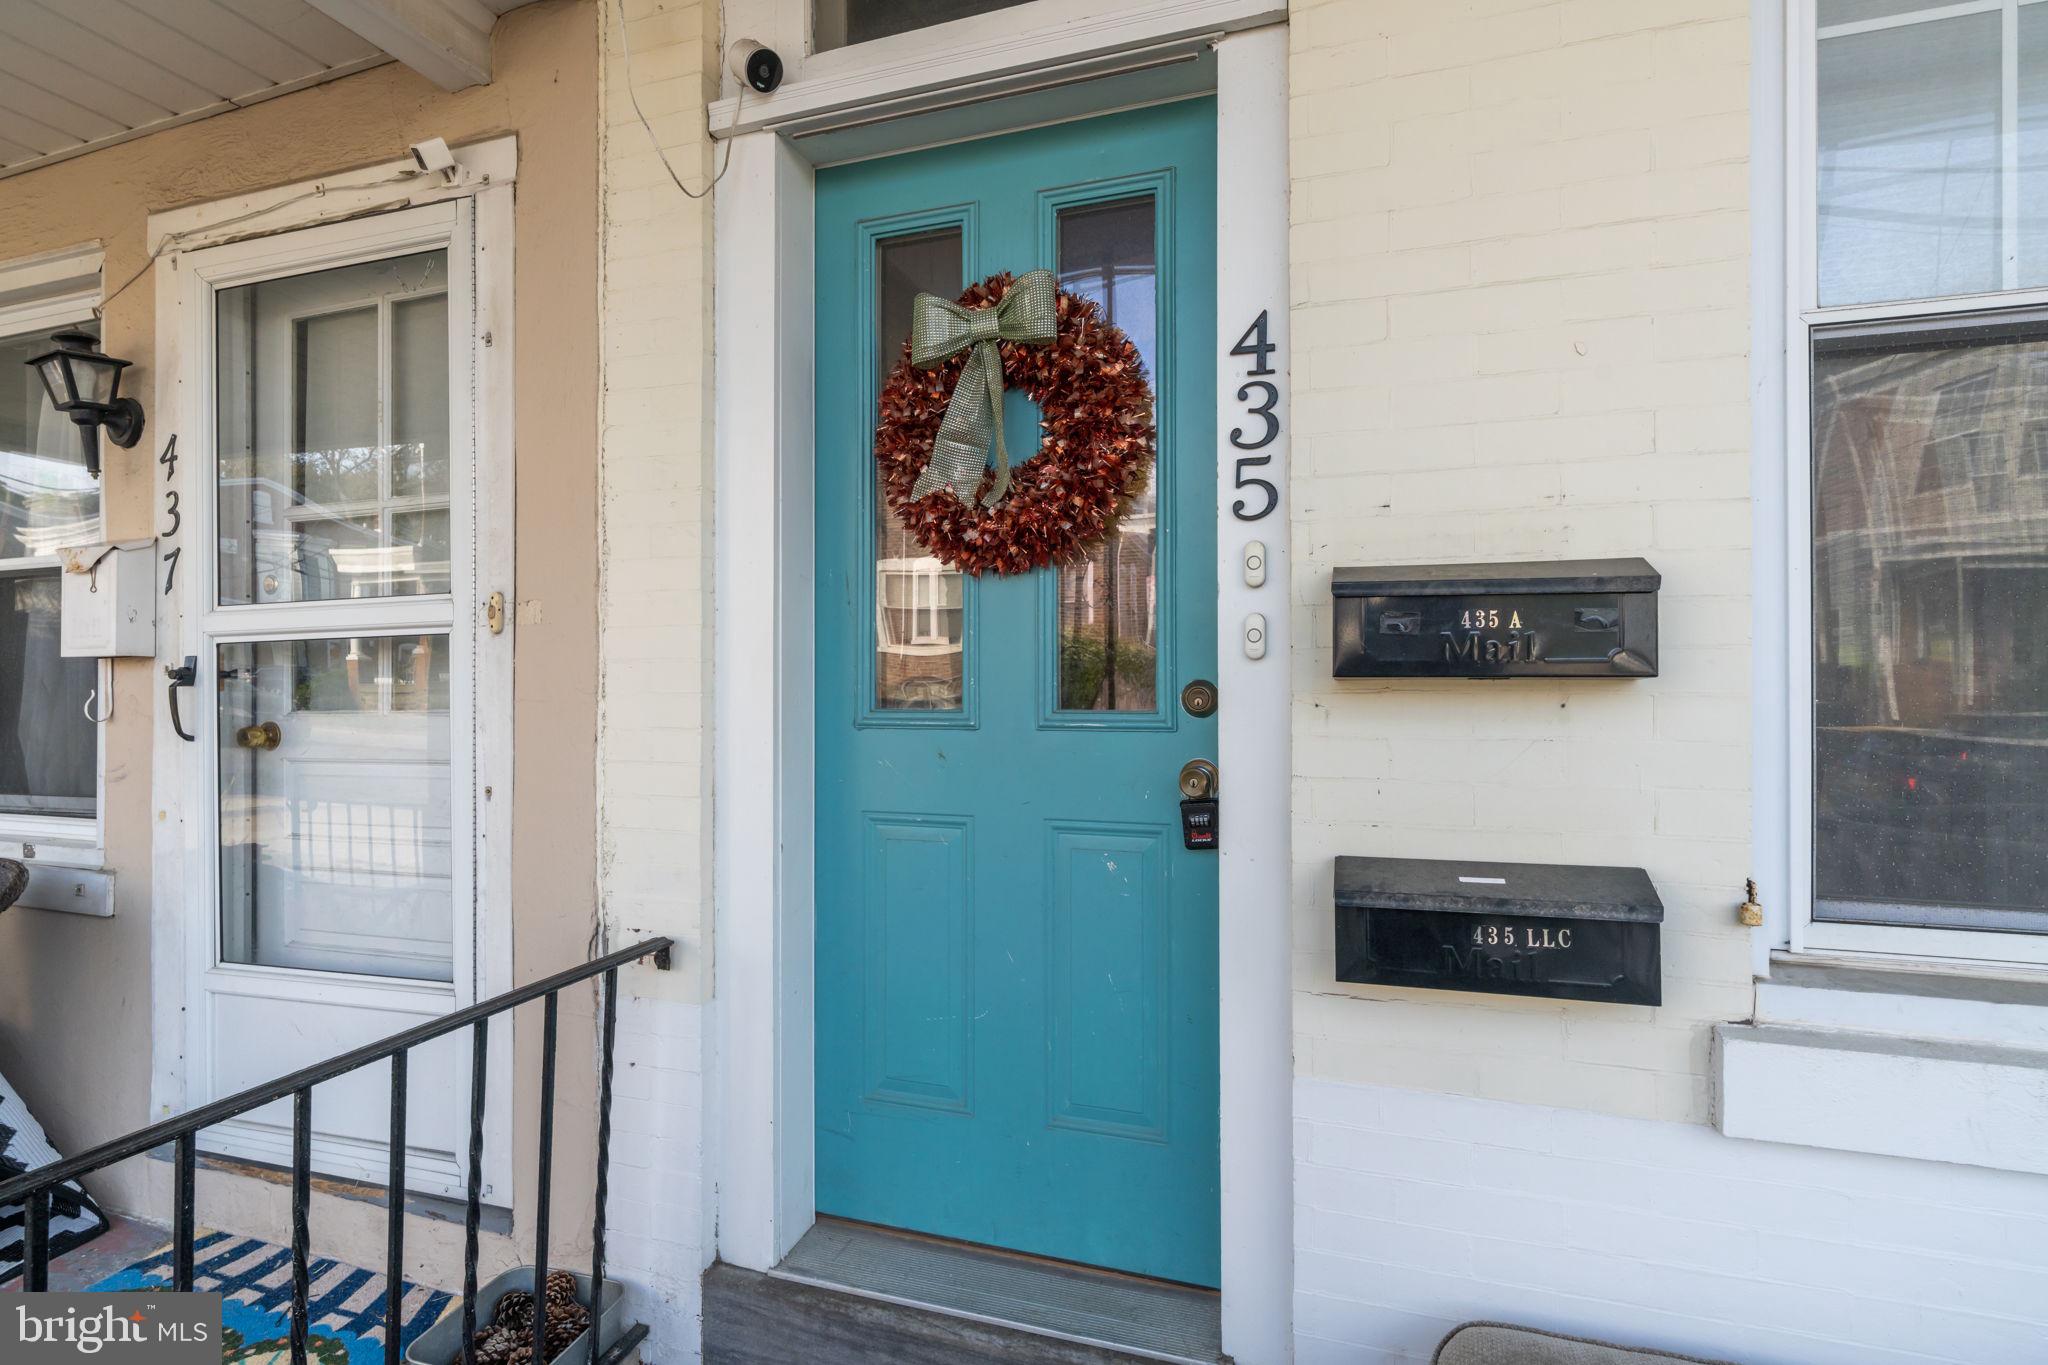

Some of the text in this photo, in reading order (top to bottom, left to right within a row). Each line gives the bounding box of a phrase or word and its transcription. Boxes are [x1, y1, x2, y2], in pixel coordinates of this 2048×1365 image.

[1230, 309, 1280, 521] 435
[160, 434, 181, 595] 437
[1461, 609, 1522, 628] 435 A
[1440, 631, 1537, 663] Mail
[1473, 926, 1571, 948] 435 LLC
